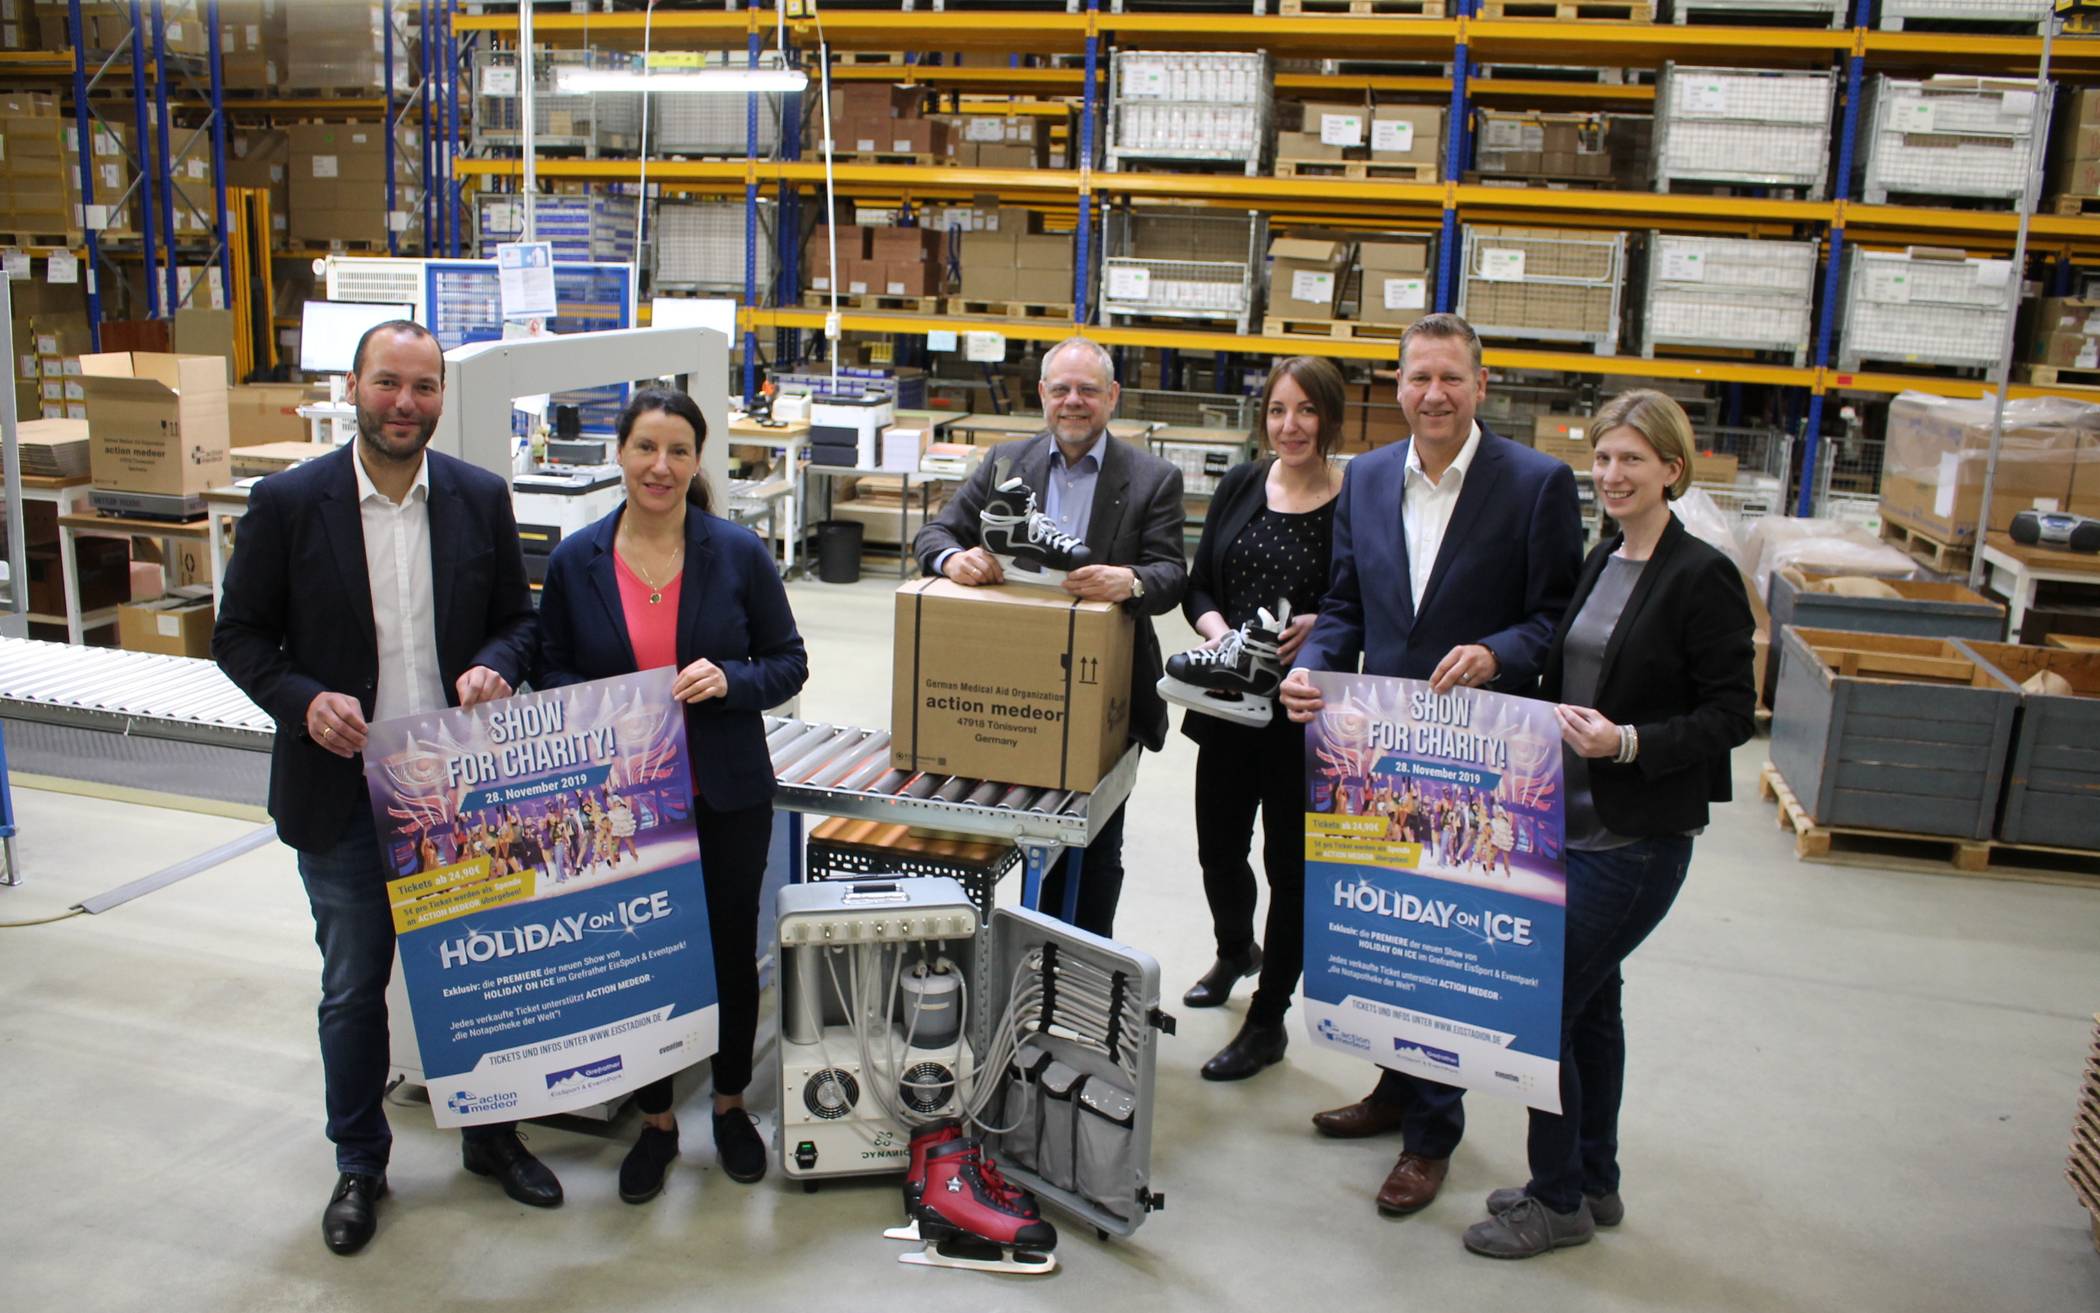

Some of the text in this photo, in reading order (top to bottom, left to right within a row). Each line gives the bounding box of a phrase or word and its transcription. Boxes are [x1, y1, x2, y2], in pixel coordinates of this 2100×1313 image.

[926, 679, 1065, 702] German Medical Aid Organization
[926, 696, 1065, 722] action medeor
[1410, 690, 1470, 728] SHOW
[489, 701, 564, 744] SHOW
[957, 717, 1038, 735] 47918 Tönisvorst
[974, 733, 1018, 748] Germany
[1368, 720, 1507, 769] FOR CHARITY!
[447, 727, 616, 788] FOR CHARITY!
[1395, 762, 1481, 784] 28. November 2019
[485, 774, 588, 804] 28. November 2019
[1313, 820, 1340, 829] Tickets
[399, 880, 432, 896] Tickets
[434, 874, 448, 886] ab
[429, 898, 452, 911] Ticket
[453, 890, 480, 902] werden
[1334, 880, 1534, 946] HOLIDAY ON ICE
[418, 910, 448, 922] ACTION
[440, 890, 674, 968] HOLIDAY ON ICE
[1370, 931, 1408, 947] PREMIERE
[484, 940, 687, 1000] HOLIDAY ON ICE im Grefrather EisSport & Eventpark!
[1358, 940, 1391, 954] HOLIDAY
[1392, 946, 1404, 956] ON
[1404, 950, 1418, 960] ICE
[1464, 962, 1494, 977] EisSport
[1494, 969, 1500, 979] &
[442, 950, 621, 998] Exklusiv: die PREMIERE der neuen Show von
[1380, 965, 1401, 978] Ticket
[1438, 980, 1468, 993] ACTION
[1468, 985, 1499, 1000] MEDEOR
[450, 1018, 474, 1030] Jedes
[476, 1009, 514, 1024] verkaufte
[515, 1004, 540, 1016] Ticket
[542, 992, 584, 1010] unterstützt
[586, 984, 617, 1000] ACTION
[618, 974, 651, 990] MEDEOR
[1352, 1000, 1377, 1014] TICKETS
[469, 1020, 521, 1038] Notapotheke
[522, 1016, 536, 1026] der
[489, 1013, 662, 1065] TICKETS UND INFOS UNTER WWW.EISSTADION.DE
[470, 1100, 518, 1113] medeor
[480, 1092, 518, 1104] action
